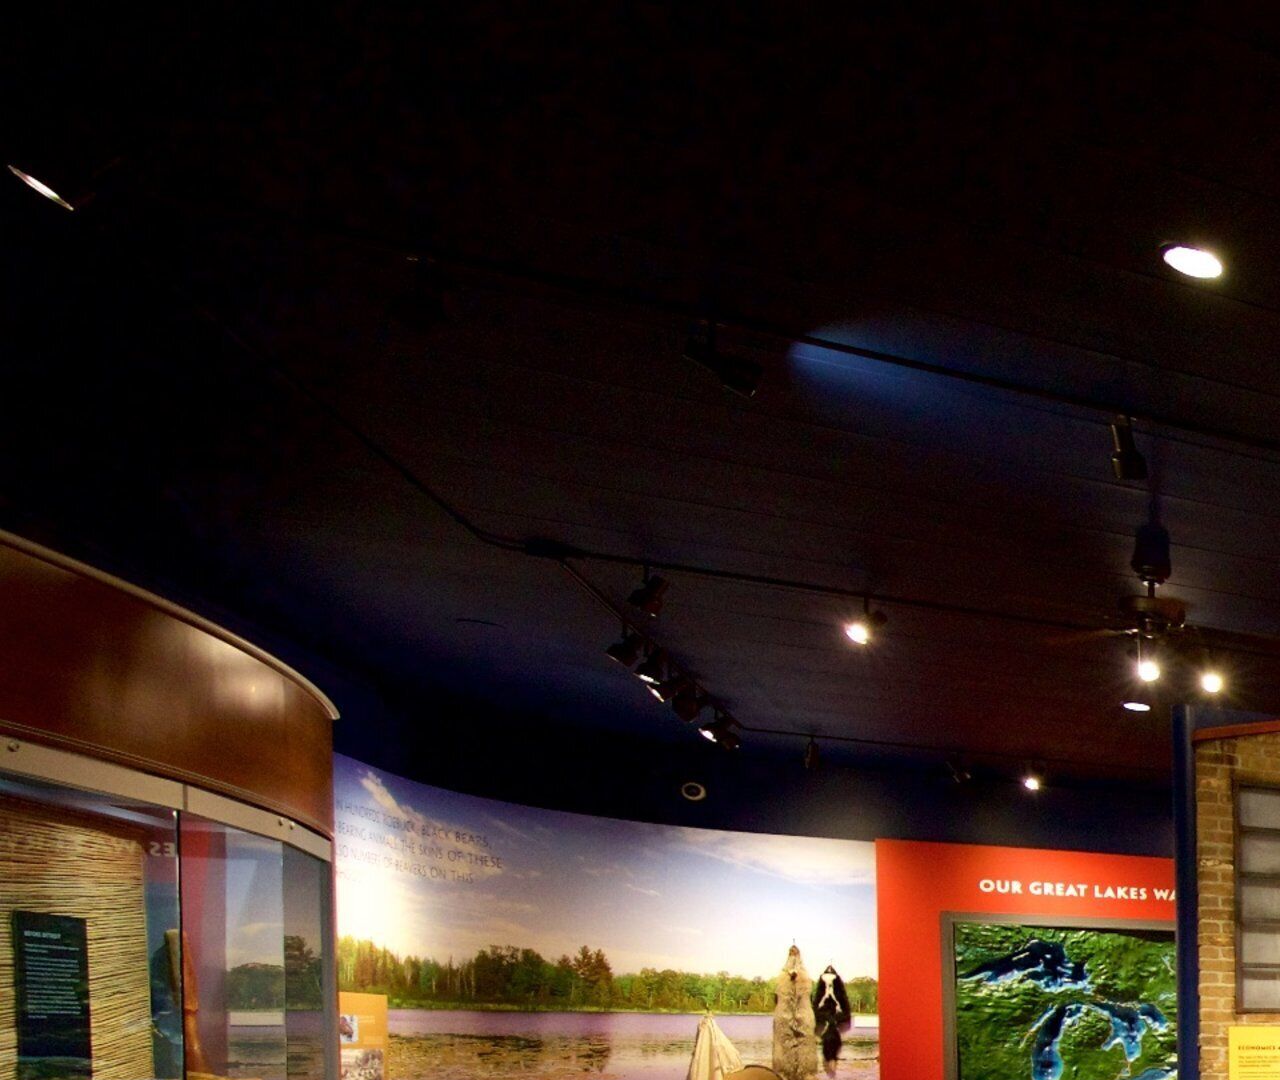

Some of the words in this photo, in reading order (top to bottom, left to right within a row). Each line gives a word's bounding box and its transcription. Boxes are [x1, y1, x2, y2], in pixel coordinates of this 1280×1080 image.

[447, 849, 463, 863] OF
[467, 852, 503, 869] THESE
[430, 866, 447, 880] ON
[979, 879, 1024, 895] OUR
[1029, 881, 1089, 898] GREAT
[1094, 884, 1147, 900] LAKES
